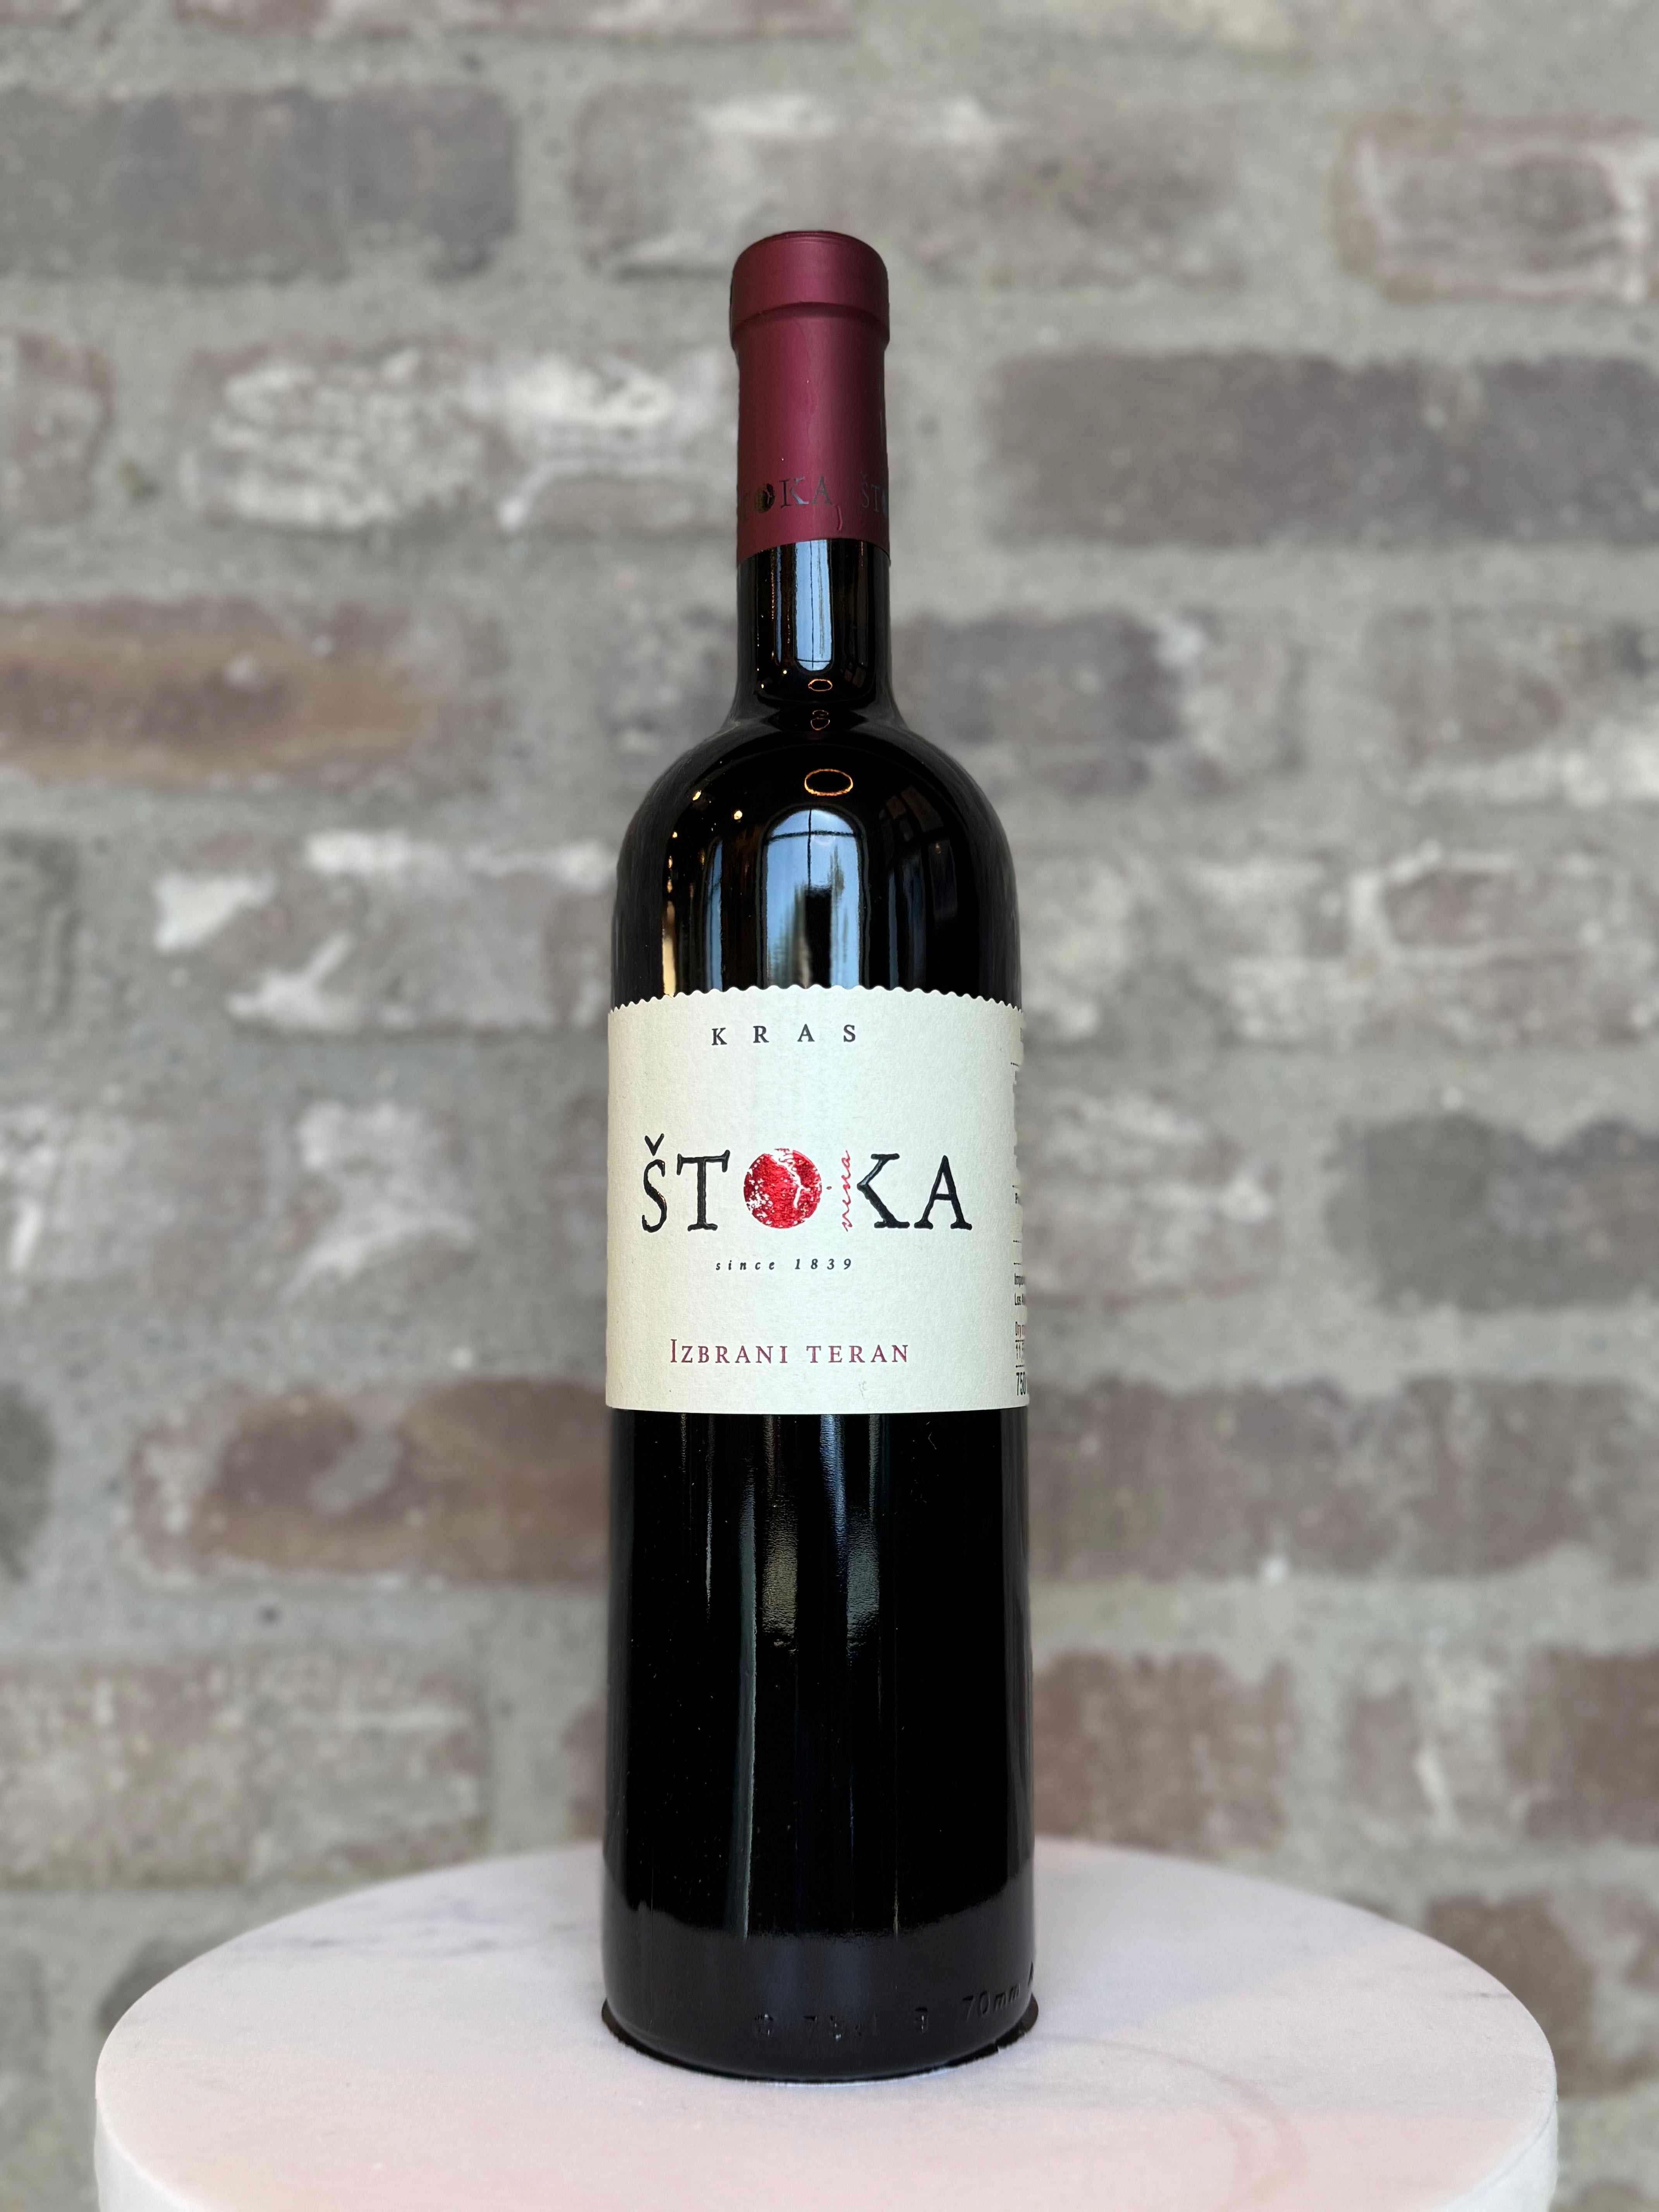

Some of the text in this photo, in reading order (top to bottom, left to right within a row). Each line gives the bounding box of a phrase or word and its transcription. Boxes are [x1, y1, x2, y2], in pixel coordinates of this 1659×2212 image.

[712, 1024, 855, 1046] KRAS
[642, 1133, 972, 1233] ŠTOKA
[716, 1258, 852, 1271] since 1839
[670, 1339, 908, 1364] IZBRANI TERAN
